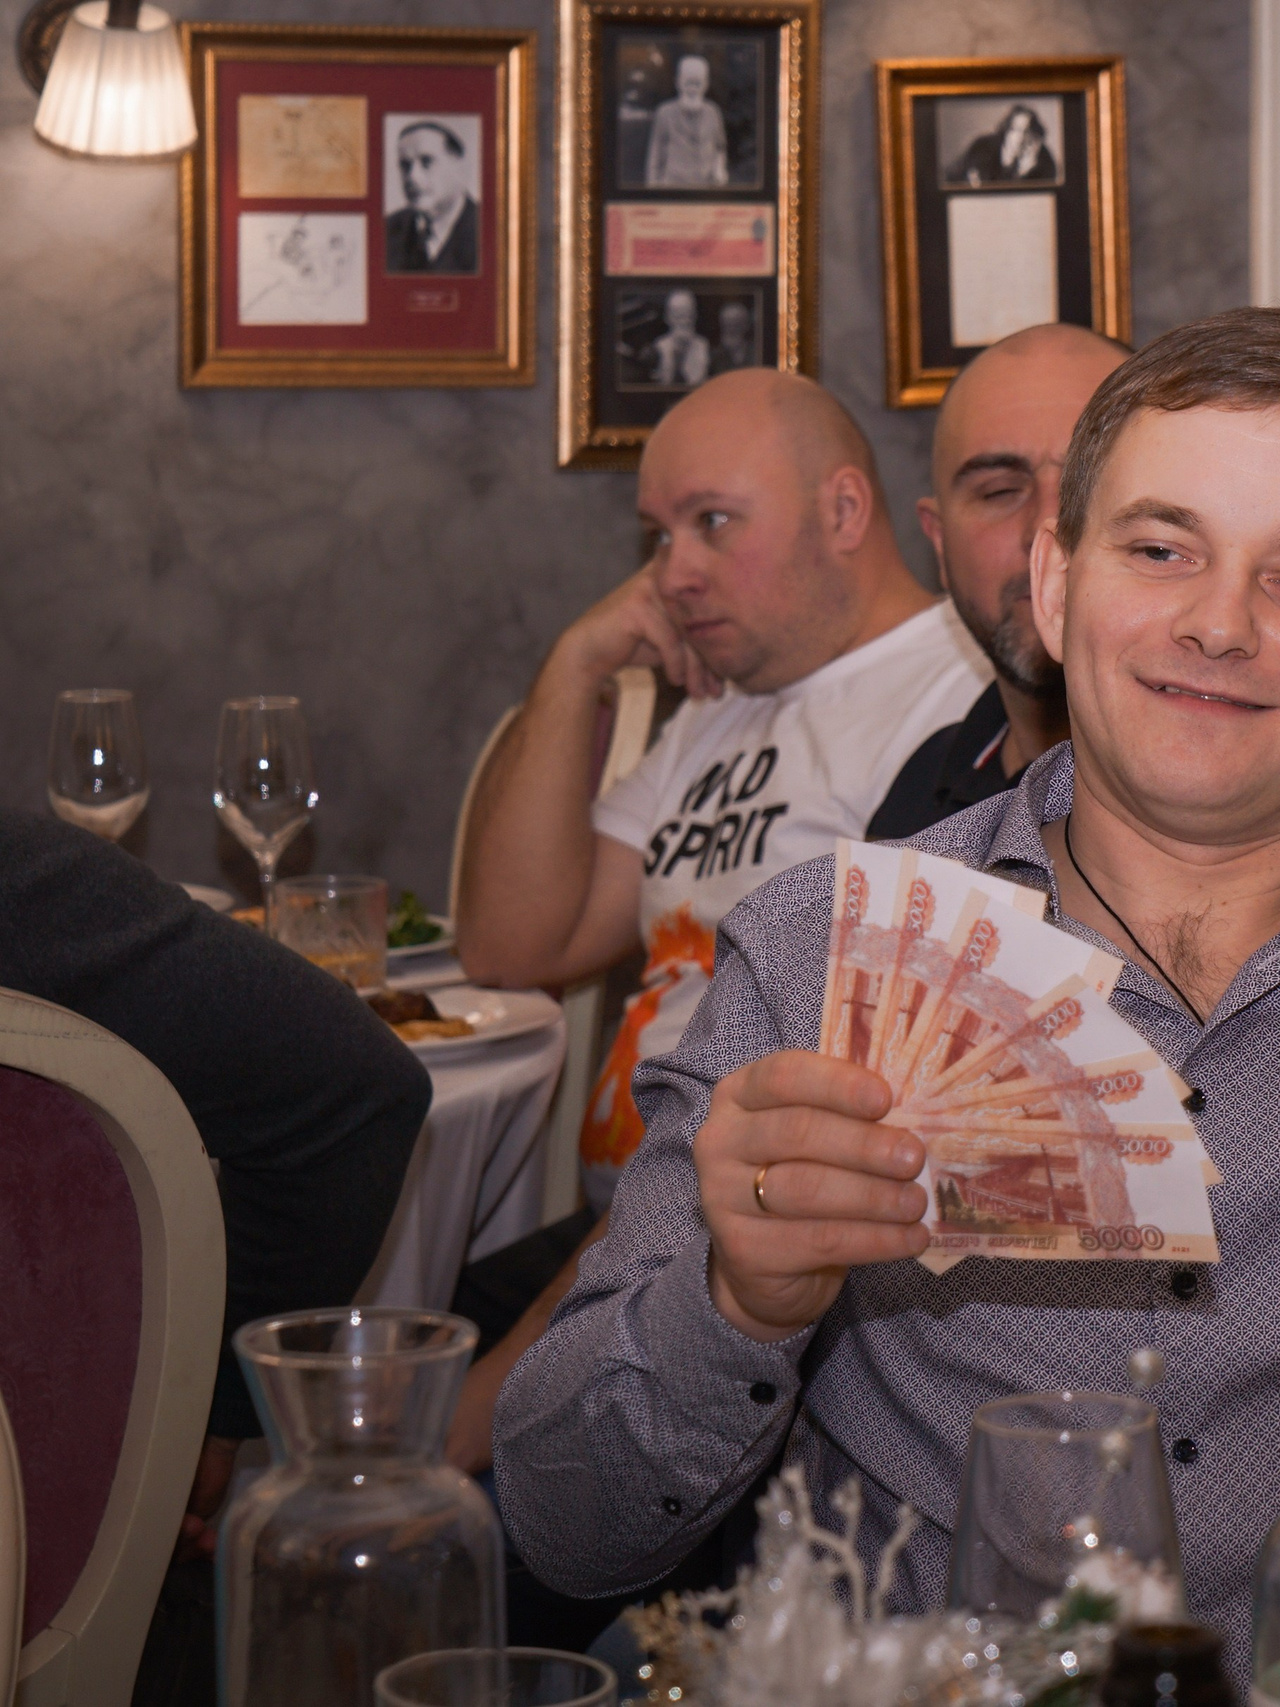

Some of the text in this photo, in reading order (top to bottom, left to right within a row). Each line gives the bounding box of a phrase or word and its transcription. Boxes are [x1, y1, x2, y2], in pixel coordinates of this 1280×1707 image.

[643, 802, 788, 880] SPIRIT
[846, 871, 862, 924] 5000
[907, 882, 928, 937] 5000
[963, 922, 992, 969] 5000
[1037, 1001, 1077, 1034] 5000
[1091, 1072, 1138, 1096] 5000
[1118, 1138, 1168, 1154] 5000
[1079, 1224, 1164, 1251] 5000
